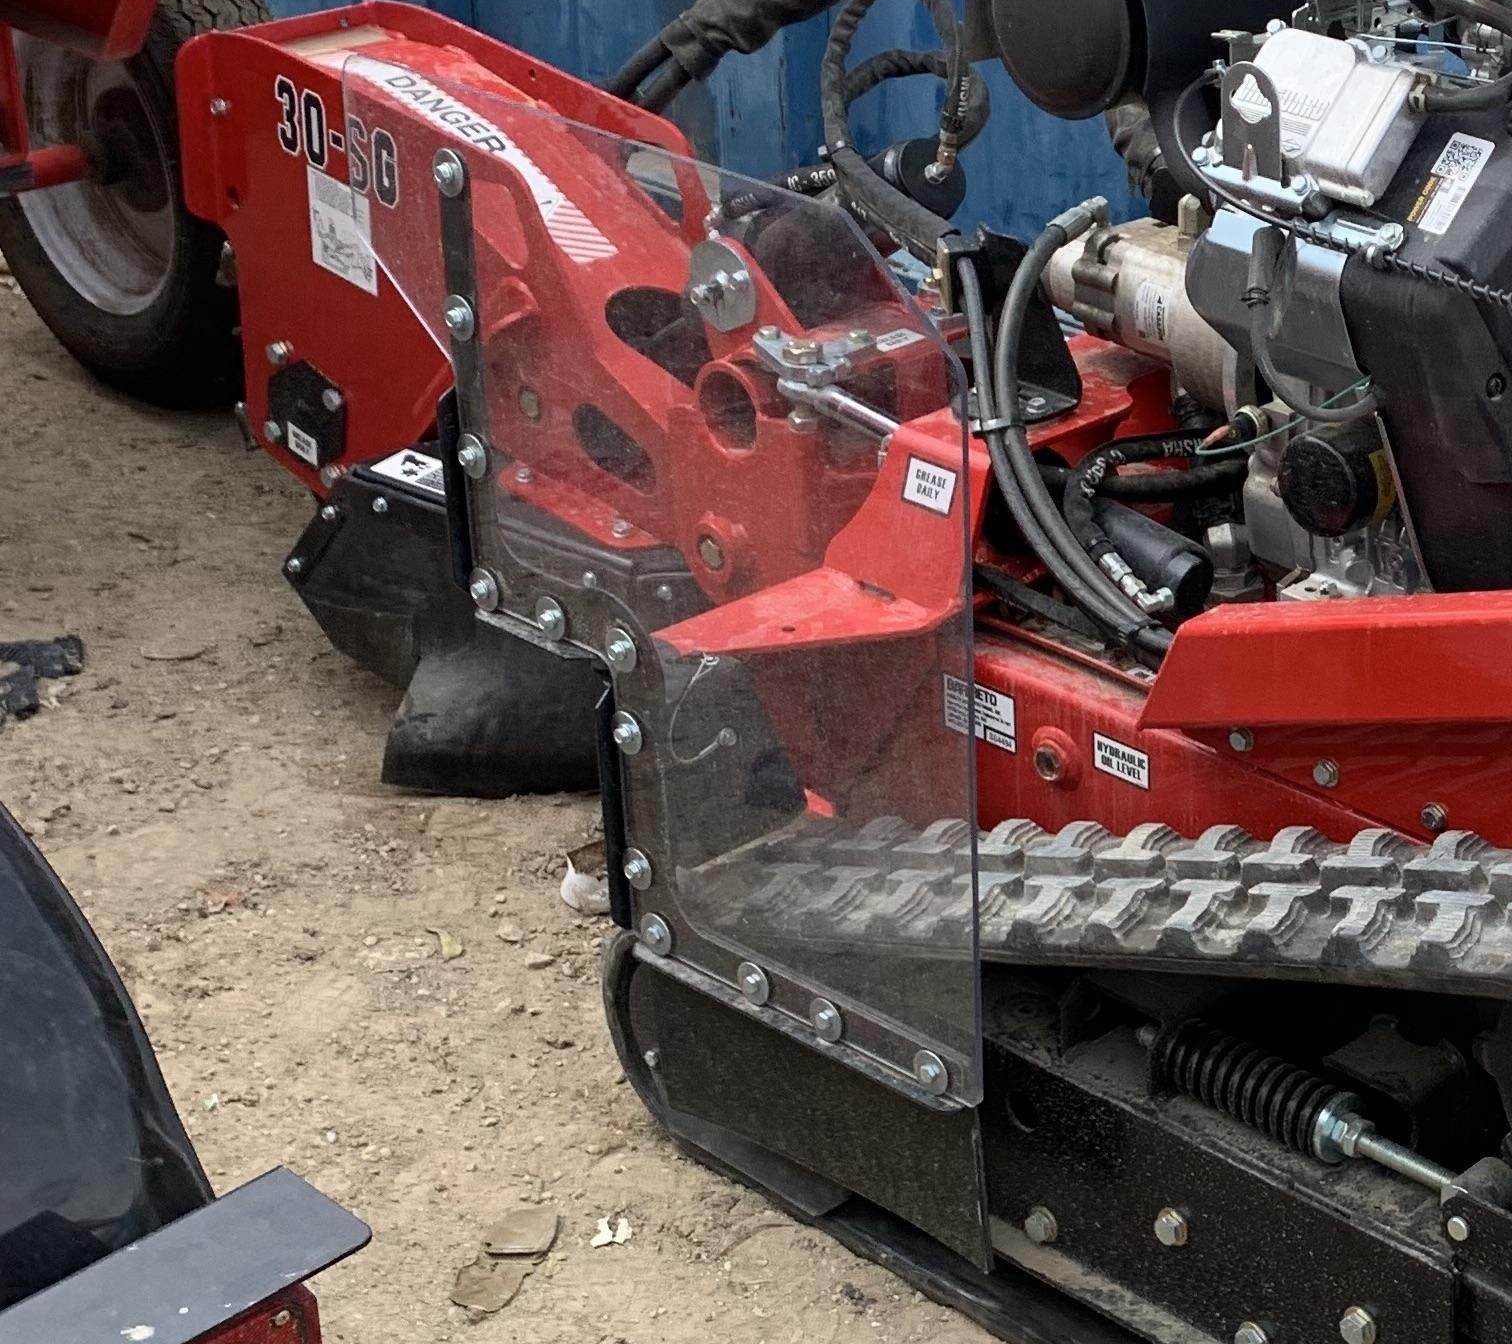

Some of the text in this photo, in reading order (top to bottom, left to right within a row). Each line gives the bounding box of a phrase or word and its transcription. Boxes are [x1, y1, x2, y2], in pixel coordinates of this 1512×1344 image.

[384, 74, 507, 153] DANGER
[274, 74, 399, 209] 30-SG
[915, 468, 947, 490] GREASE
[916, 482, 940, 501] DAILY
[1096, 739, 1147, 771] HYDRAULIC
[1101, 754, 1142, 782] OIL LEVEL
